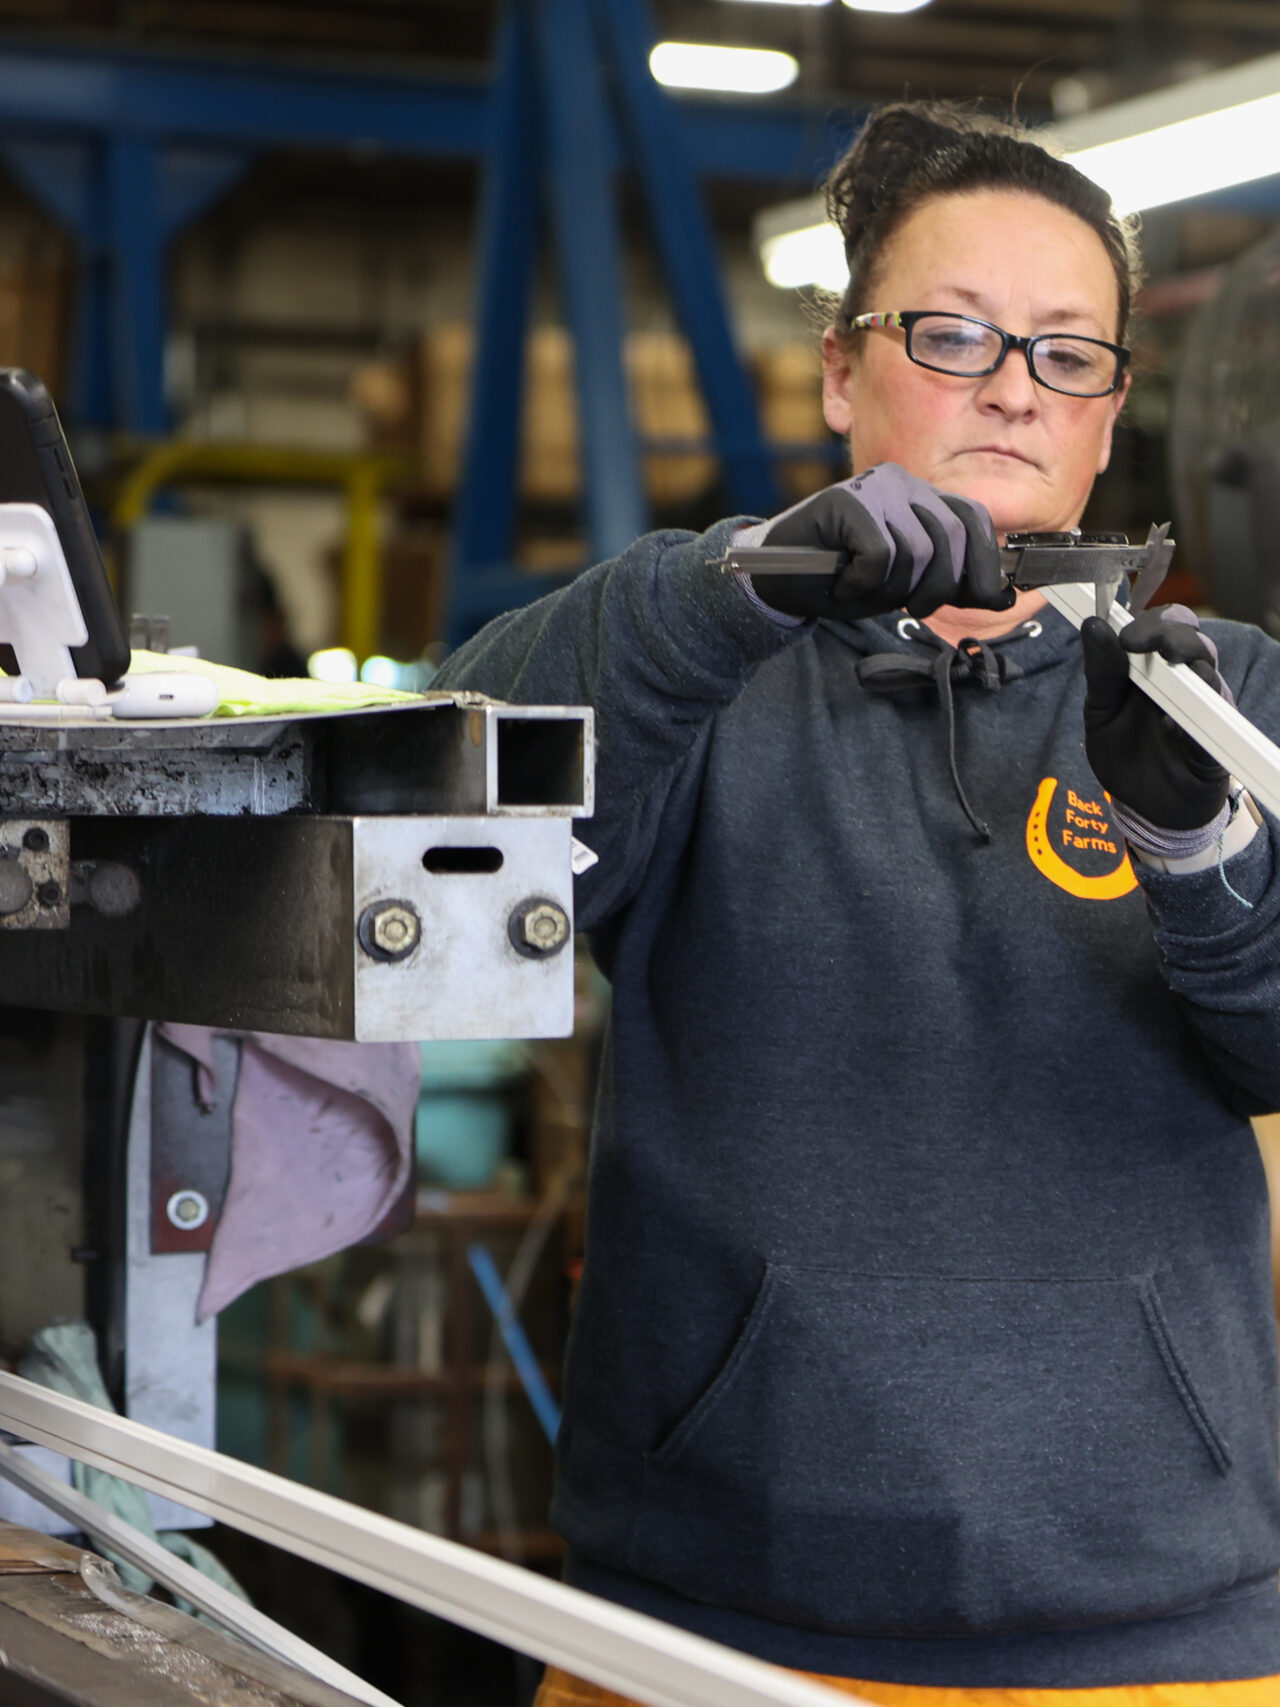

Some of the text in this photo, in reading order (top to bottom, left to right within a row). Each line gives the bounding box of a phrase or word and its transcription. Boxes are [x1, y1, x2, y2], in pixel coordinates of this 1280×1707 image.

[1067, 790, 1103, 816] Back
[1065, 809, 1109, 834] Forty
[1062, 829, 1117, 854] Farms
